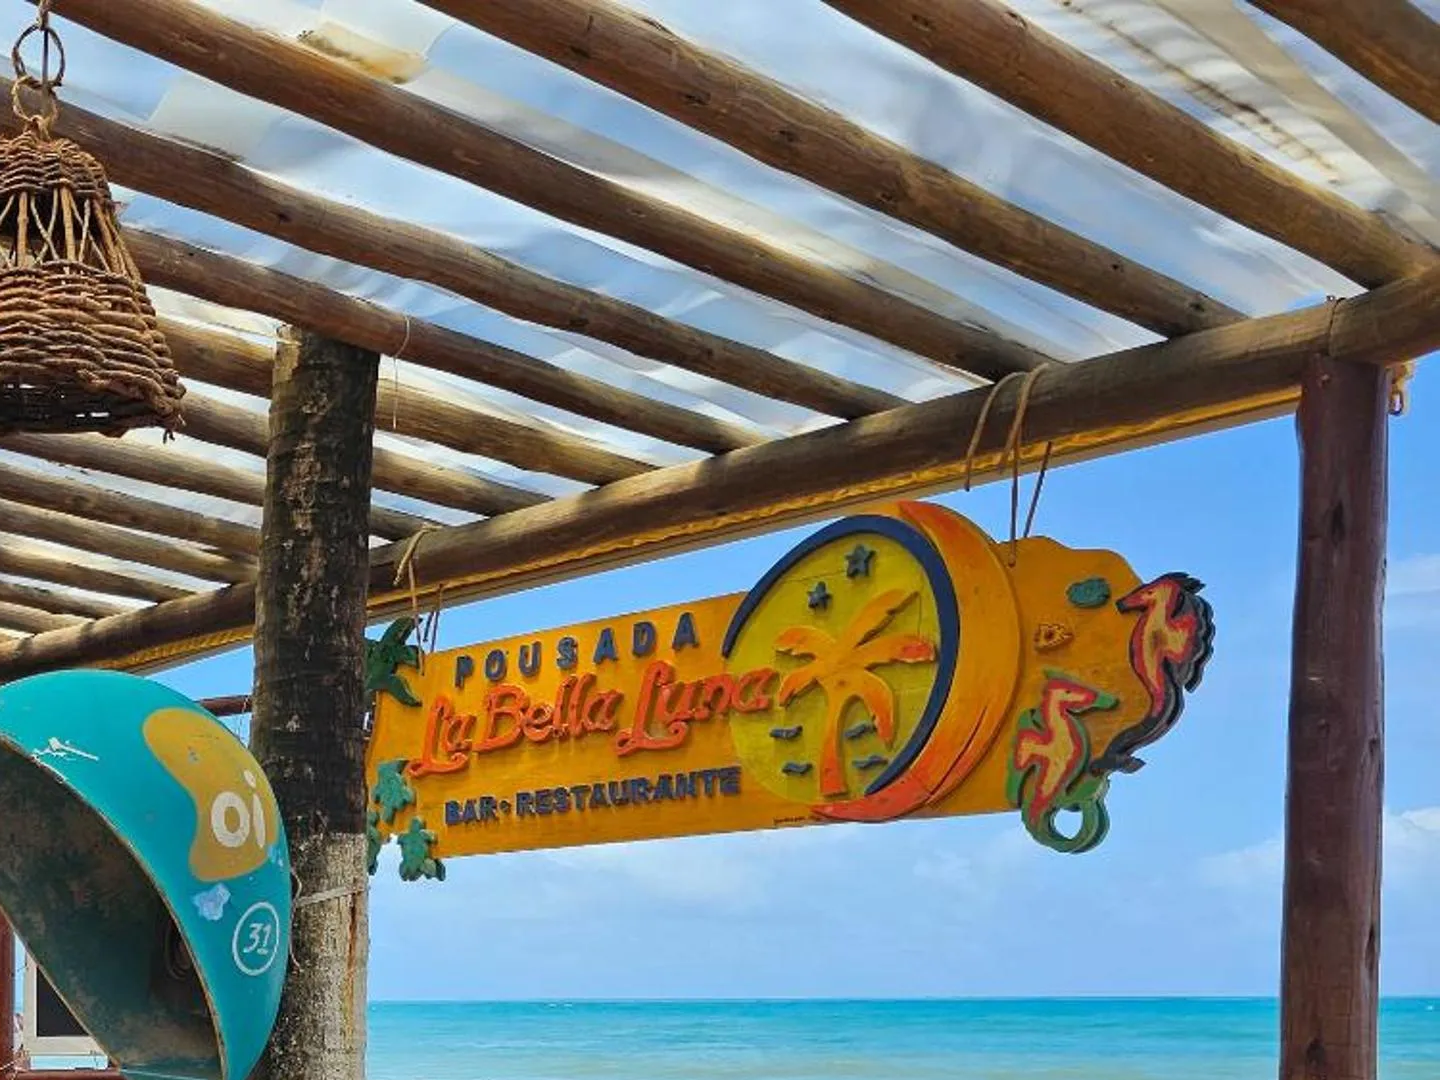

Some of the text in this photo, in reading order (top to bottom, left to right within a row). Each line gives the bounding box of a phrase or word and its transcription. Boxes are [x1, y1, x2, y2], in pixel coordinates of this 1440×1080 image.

[455, 612, 699, 688] POUSADA
[407, 660, 781, 778] La Bella Luna
[445, 766, 742, 825] BAR RESTAURANTE
[243, 923, 272, 955] 31
